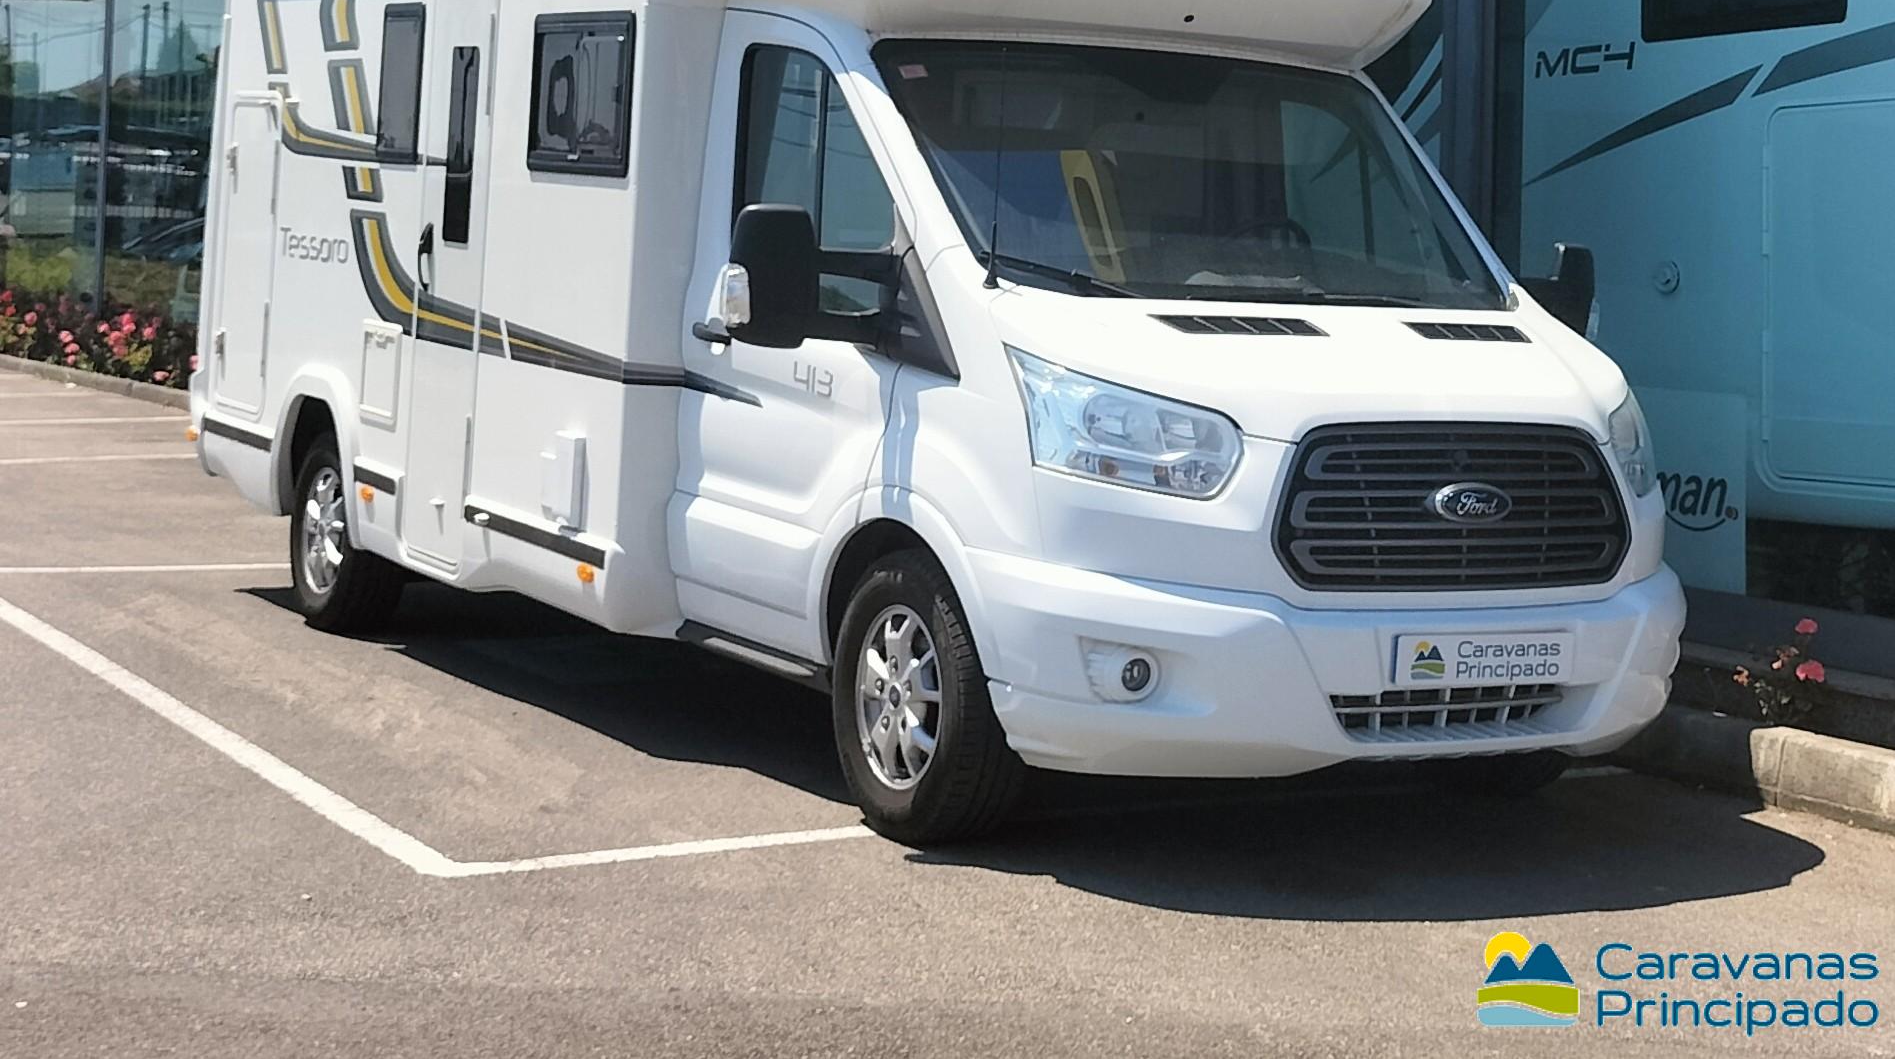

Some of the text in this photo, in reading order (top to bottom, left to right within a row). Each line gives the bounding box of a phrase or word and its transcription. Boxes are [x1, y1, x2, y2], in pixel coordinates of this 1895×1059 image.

[1535, 41, 1636, 79] MC4
[280, 226, 349, 264] Tessoro
[793, 360, 834, 398] 413
[1456, 491, 1498, 515] Ford
[1457, 640, 1561, 659] Caravanas
[1456, 659, 1560, 681] Principado
